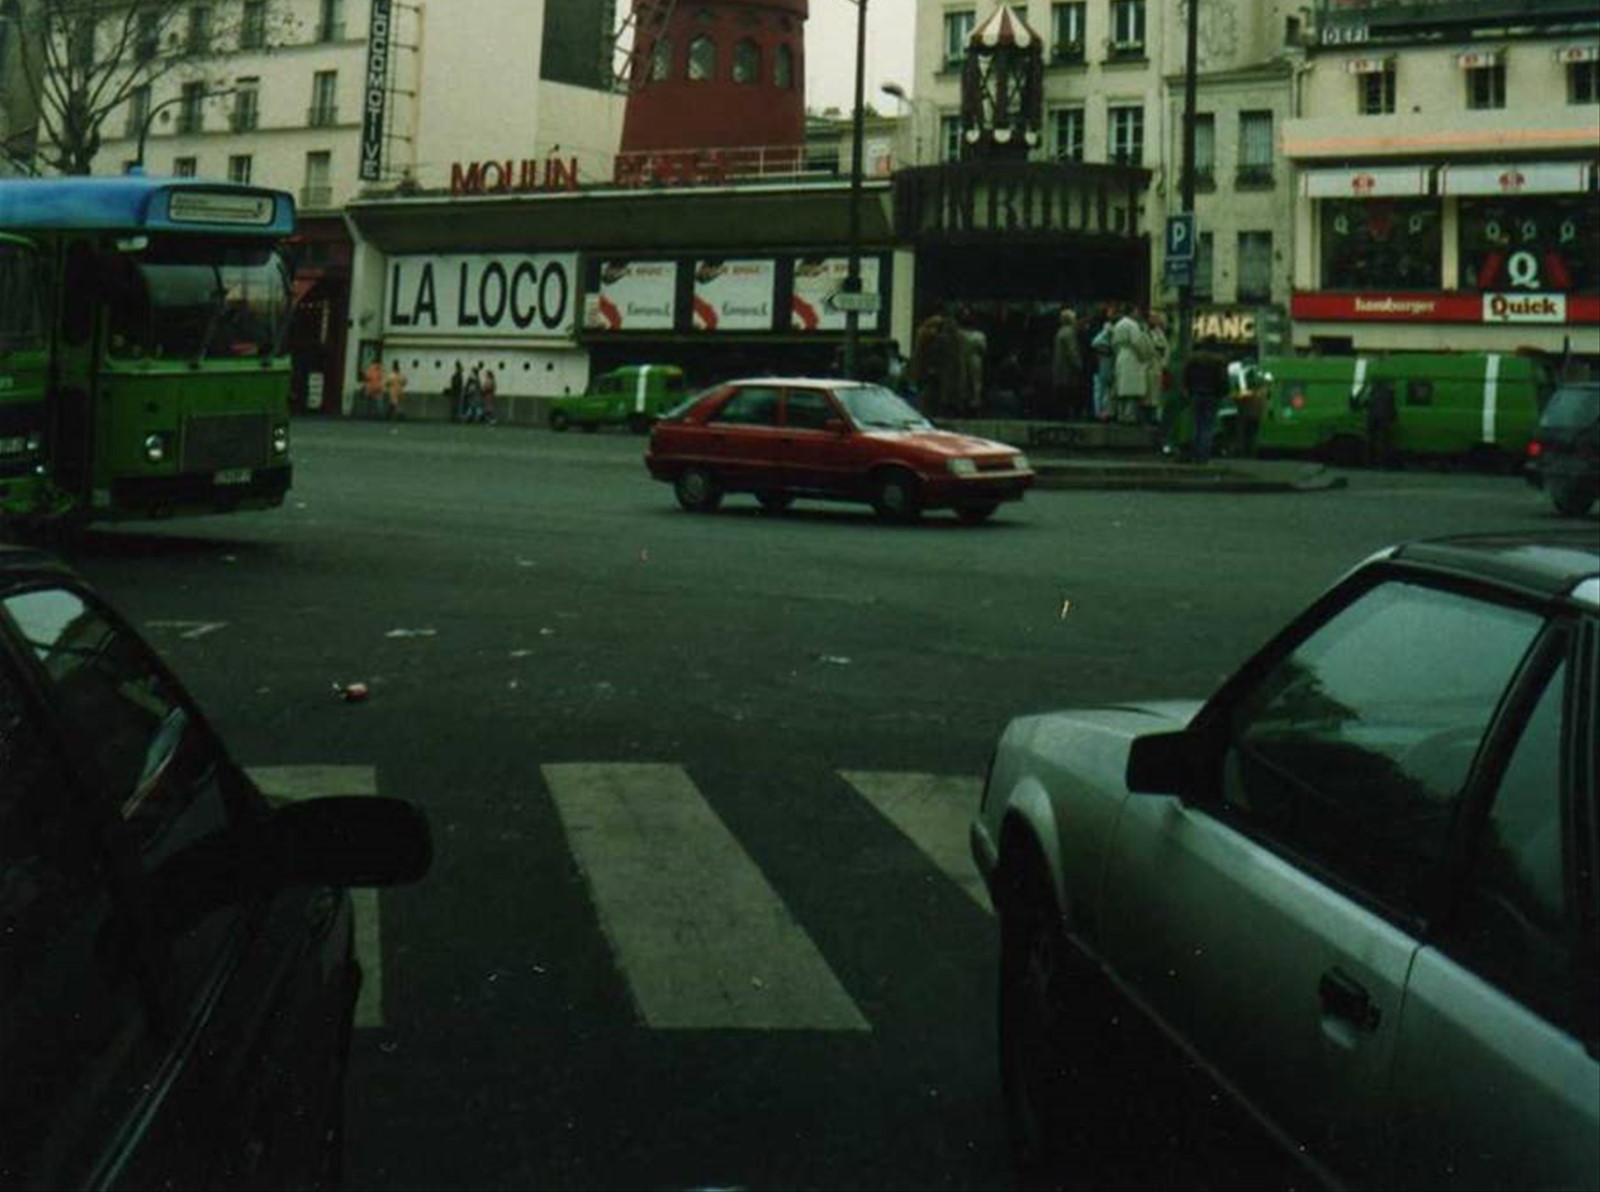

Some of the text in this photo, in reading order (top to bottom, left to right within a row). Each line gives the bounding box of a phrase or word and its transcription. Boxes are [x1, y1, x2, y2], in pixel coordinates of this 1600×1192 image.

[363, 0, 389, 177] LOCOMOTIVE
[451, 157, 579, 194] MOULIN
[1172, 222, 1186, 251] P
[1508, 252, 1540, 288] Q
[390, 260, 568, 330] LA LOCO
[1491, 294, 1557, 321] Quick
